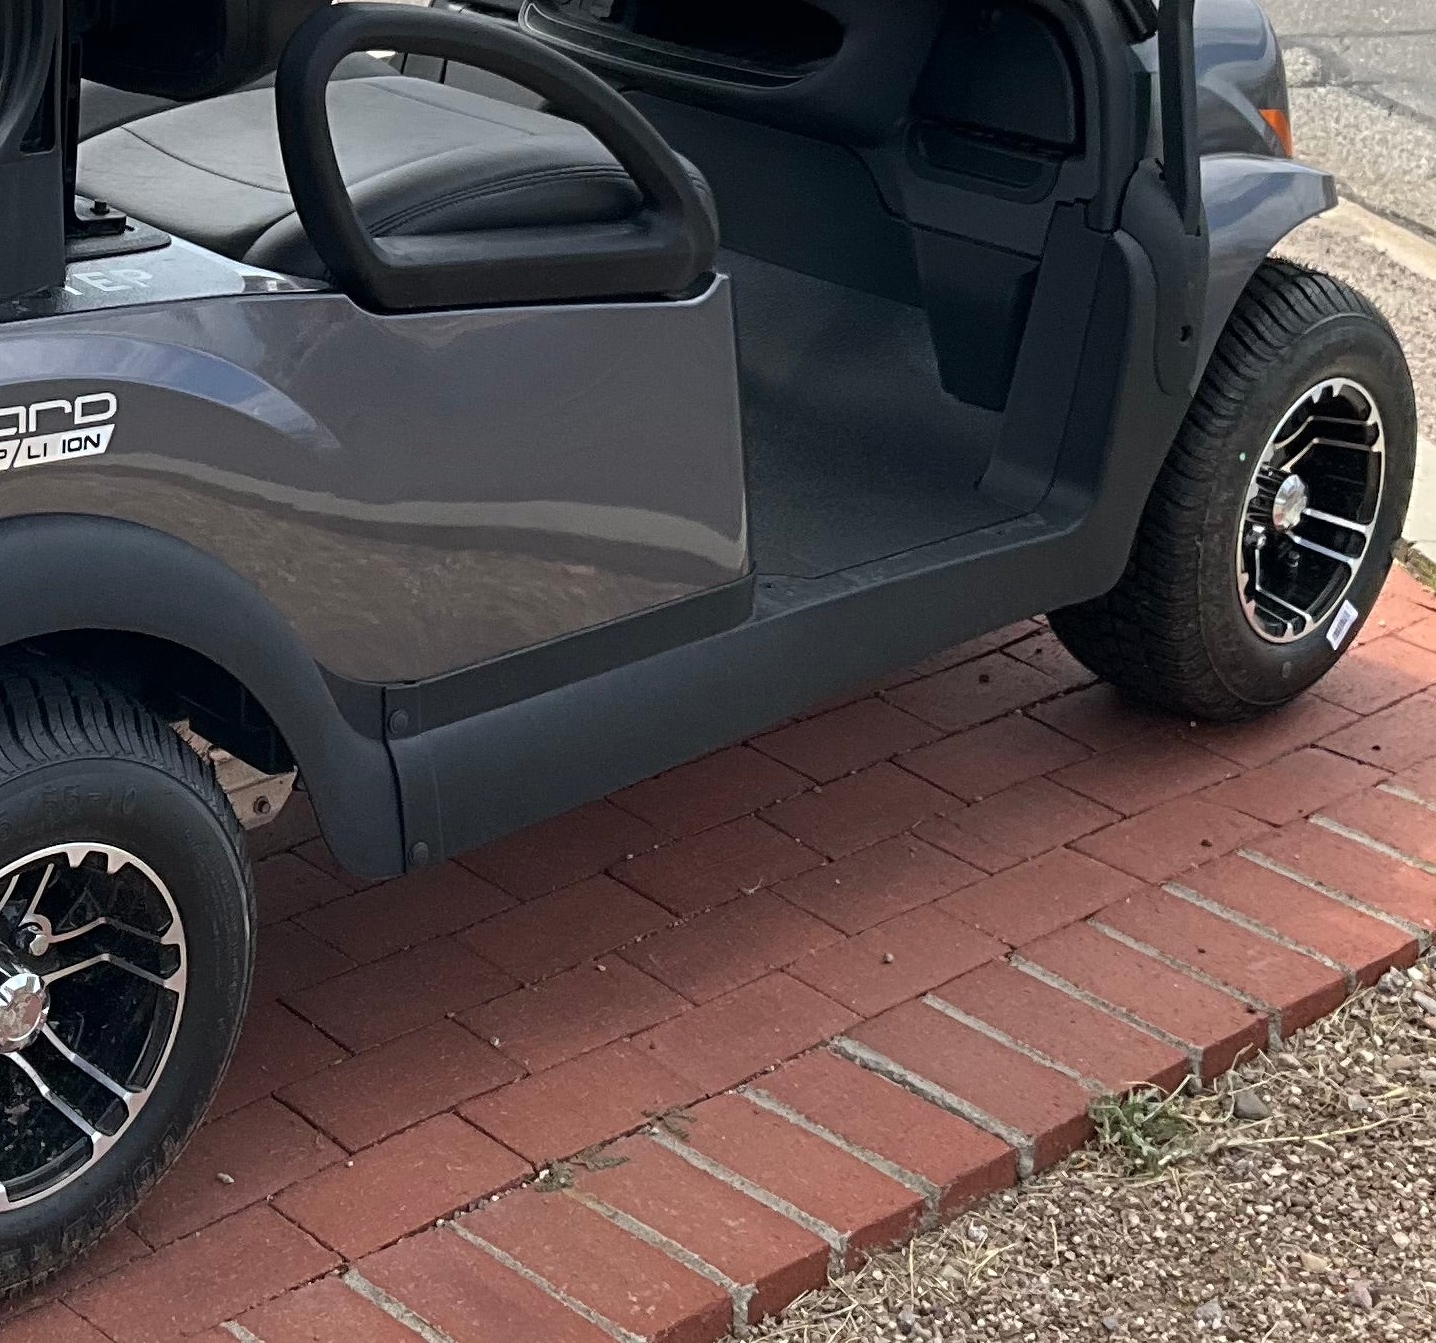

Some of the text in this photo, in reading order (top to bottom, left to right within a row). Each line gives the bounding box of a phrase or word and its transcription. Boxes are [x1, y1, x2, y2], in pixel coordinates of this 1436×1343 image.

[64, 268, 153, 296] EP
[27, 441, 48, 460] LI
[61, 433, 101, 455] ION
